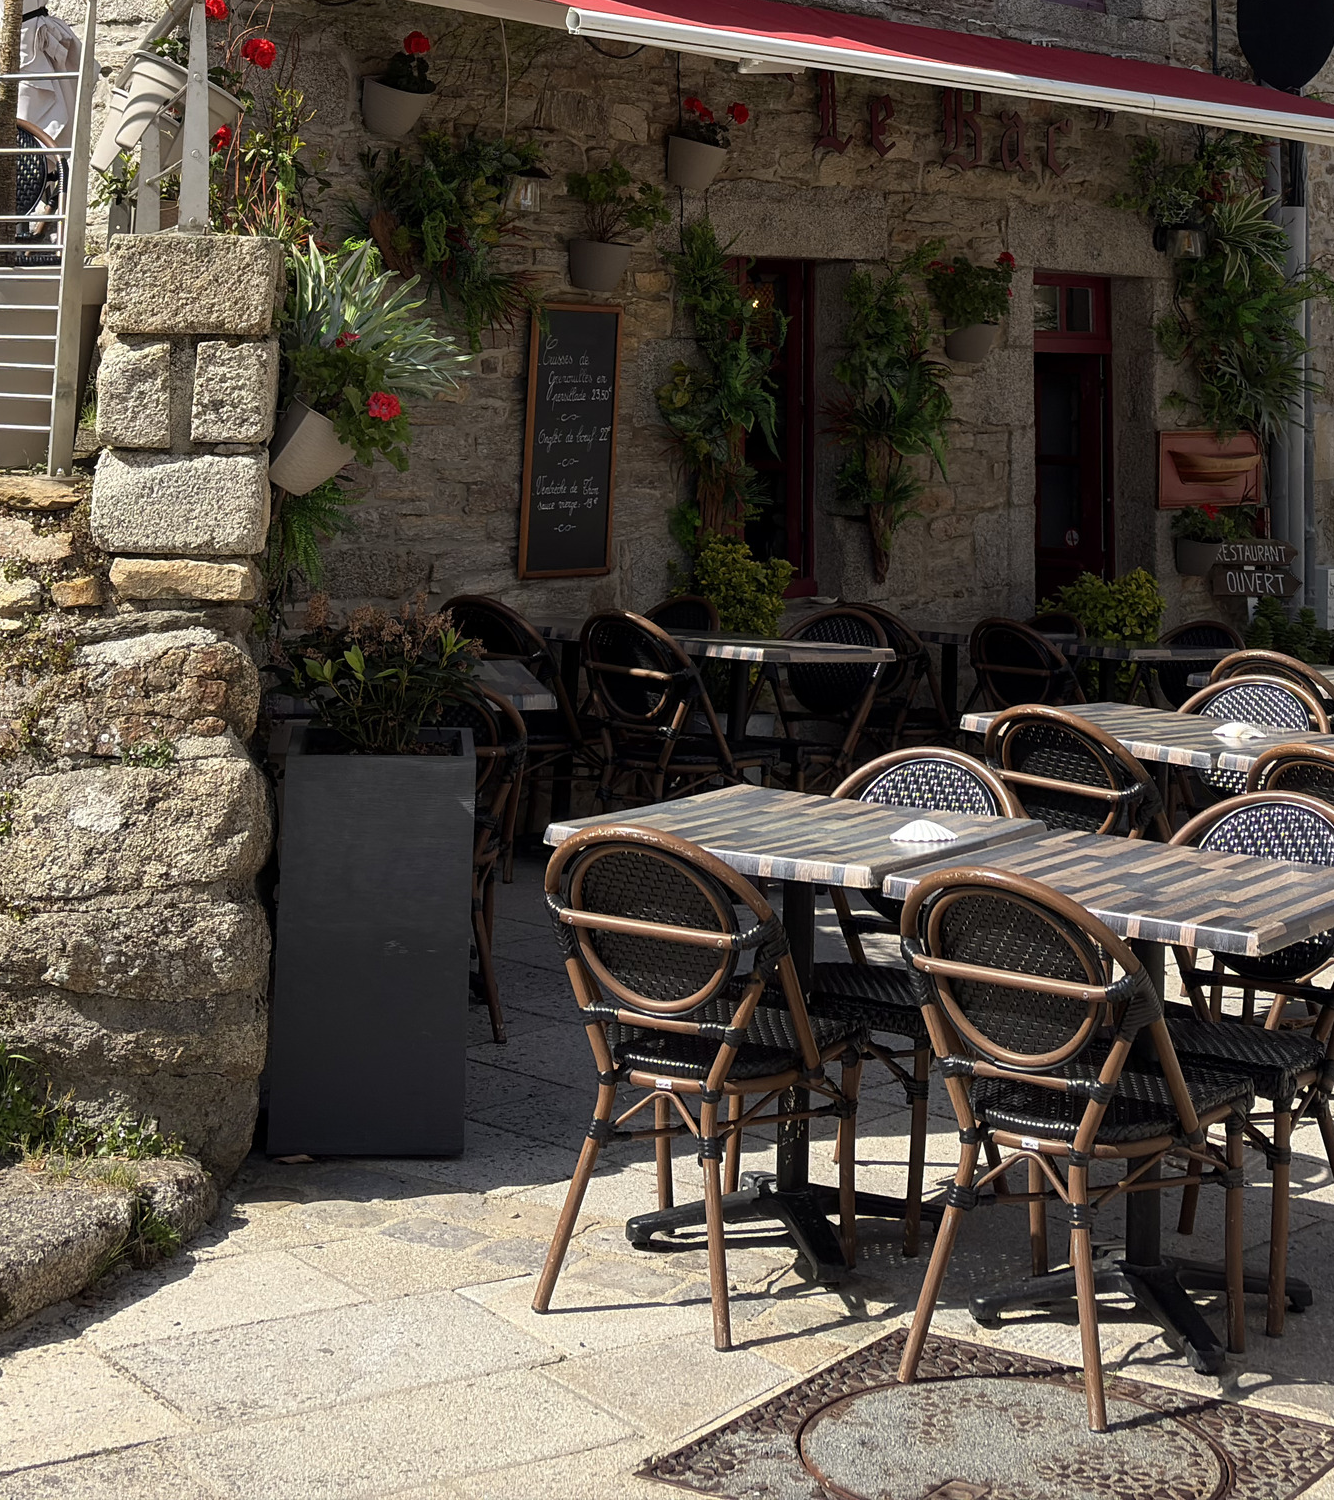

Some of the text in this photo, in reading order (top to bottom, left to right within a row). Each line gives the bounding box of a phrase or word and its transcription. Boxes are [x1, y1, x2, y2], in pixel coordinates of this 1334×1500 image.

[579, 349, 590, 366] de
[565, 429, 574, 444] de
[570, 479, 578, 494] de
[1215, 544, 1286, 563] RESTAURANT
[1226, 571, 1285, 594] OUVERT
